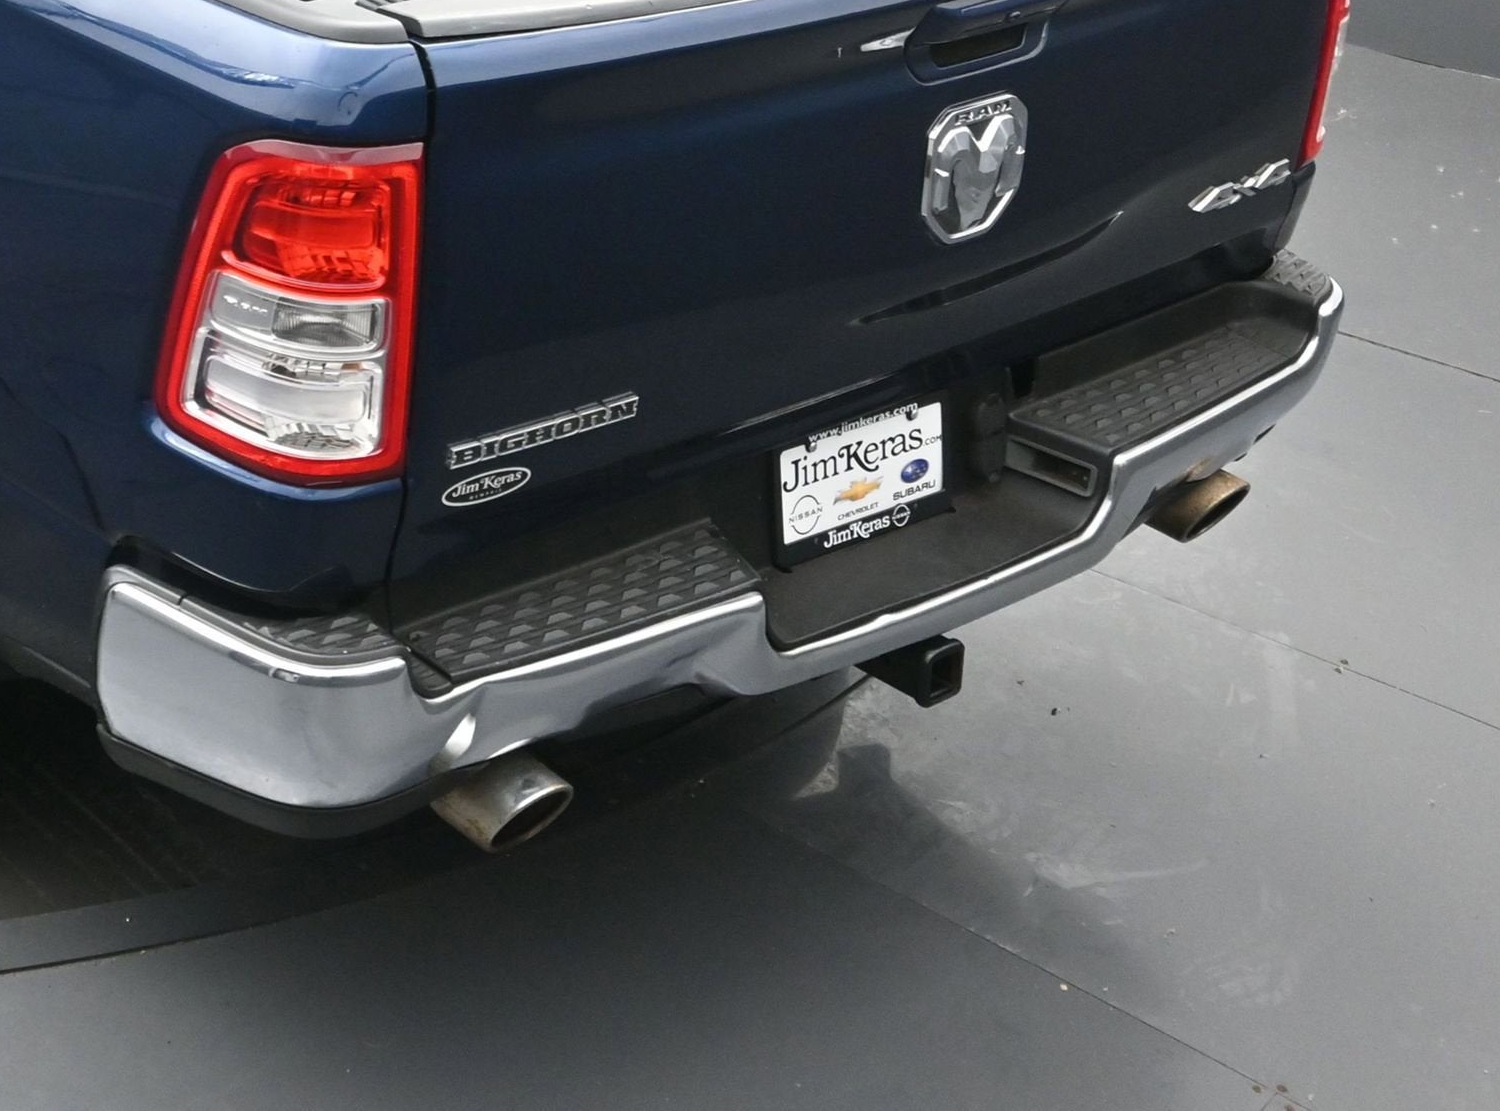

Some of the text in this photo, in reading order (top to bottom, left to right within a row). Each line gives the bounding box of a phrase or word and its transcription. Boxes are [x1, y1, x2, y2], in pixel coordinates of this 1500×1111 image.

[954, 99, 1013, 126] RAM
[808, 402, 919, 442] www.jimkeras.com
[892, 479, 936, 502] SUBARU
[787, 506, 824, 524] NISSAN
[837, 502, 880, 521] CHEVROLET
